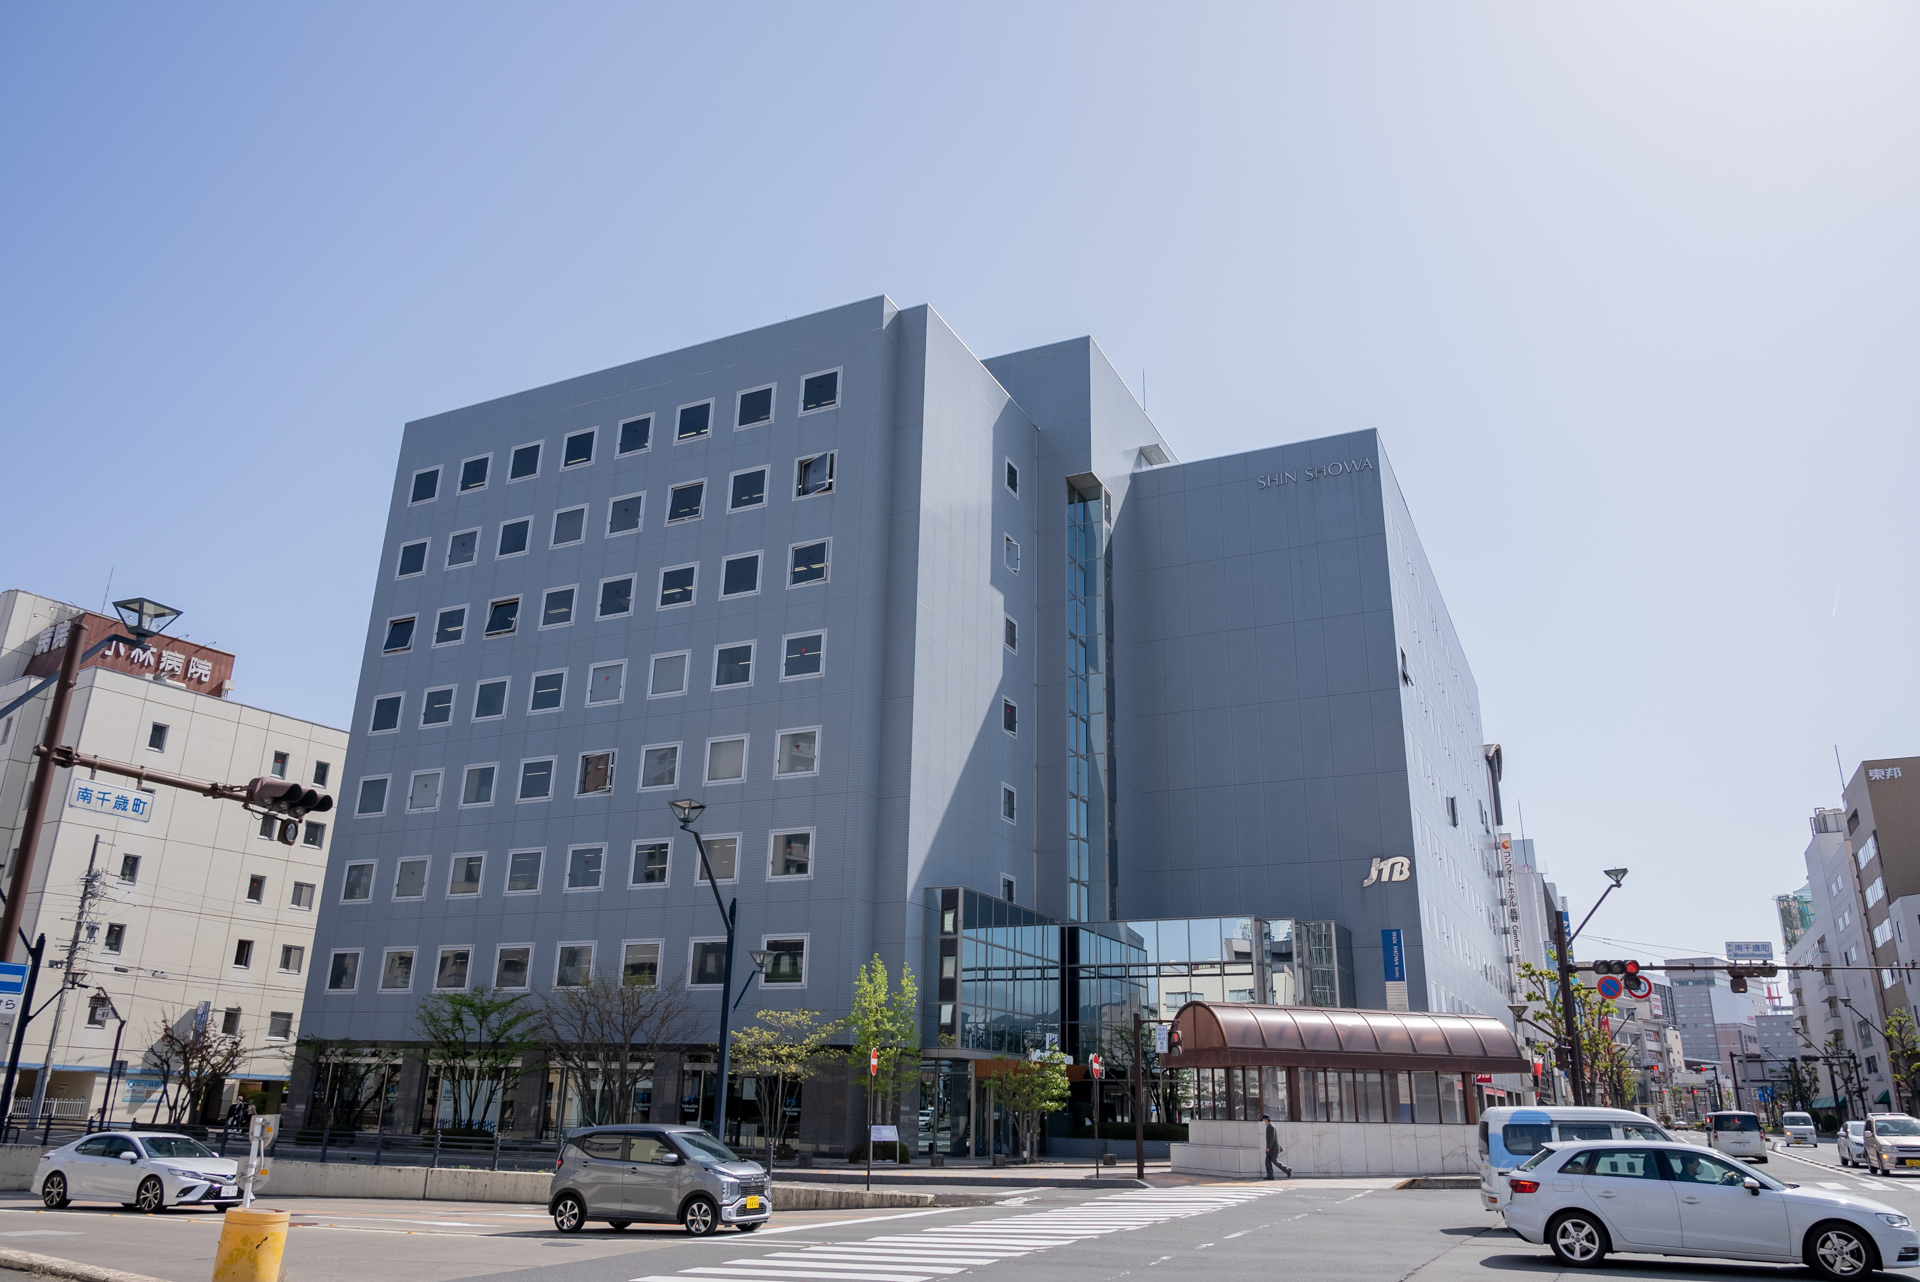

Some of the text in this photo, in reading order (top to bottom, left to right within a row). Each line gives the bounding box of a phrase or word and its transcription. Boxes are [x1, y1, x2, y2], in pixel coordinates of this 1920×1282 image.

[1257, 457, 1374, 490] SHIN SHOWA
[1868, 767, 1902, 781] 東邦
[76, 786, 148, 817] 南千歳町
[1362, 855, 1411, 888] JTB
[1511, 924, 1521, 952] Comfort
